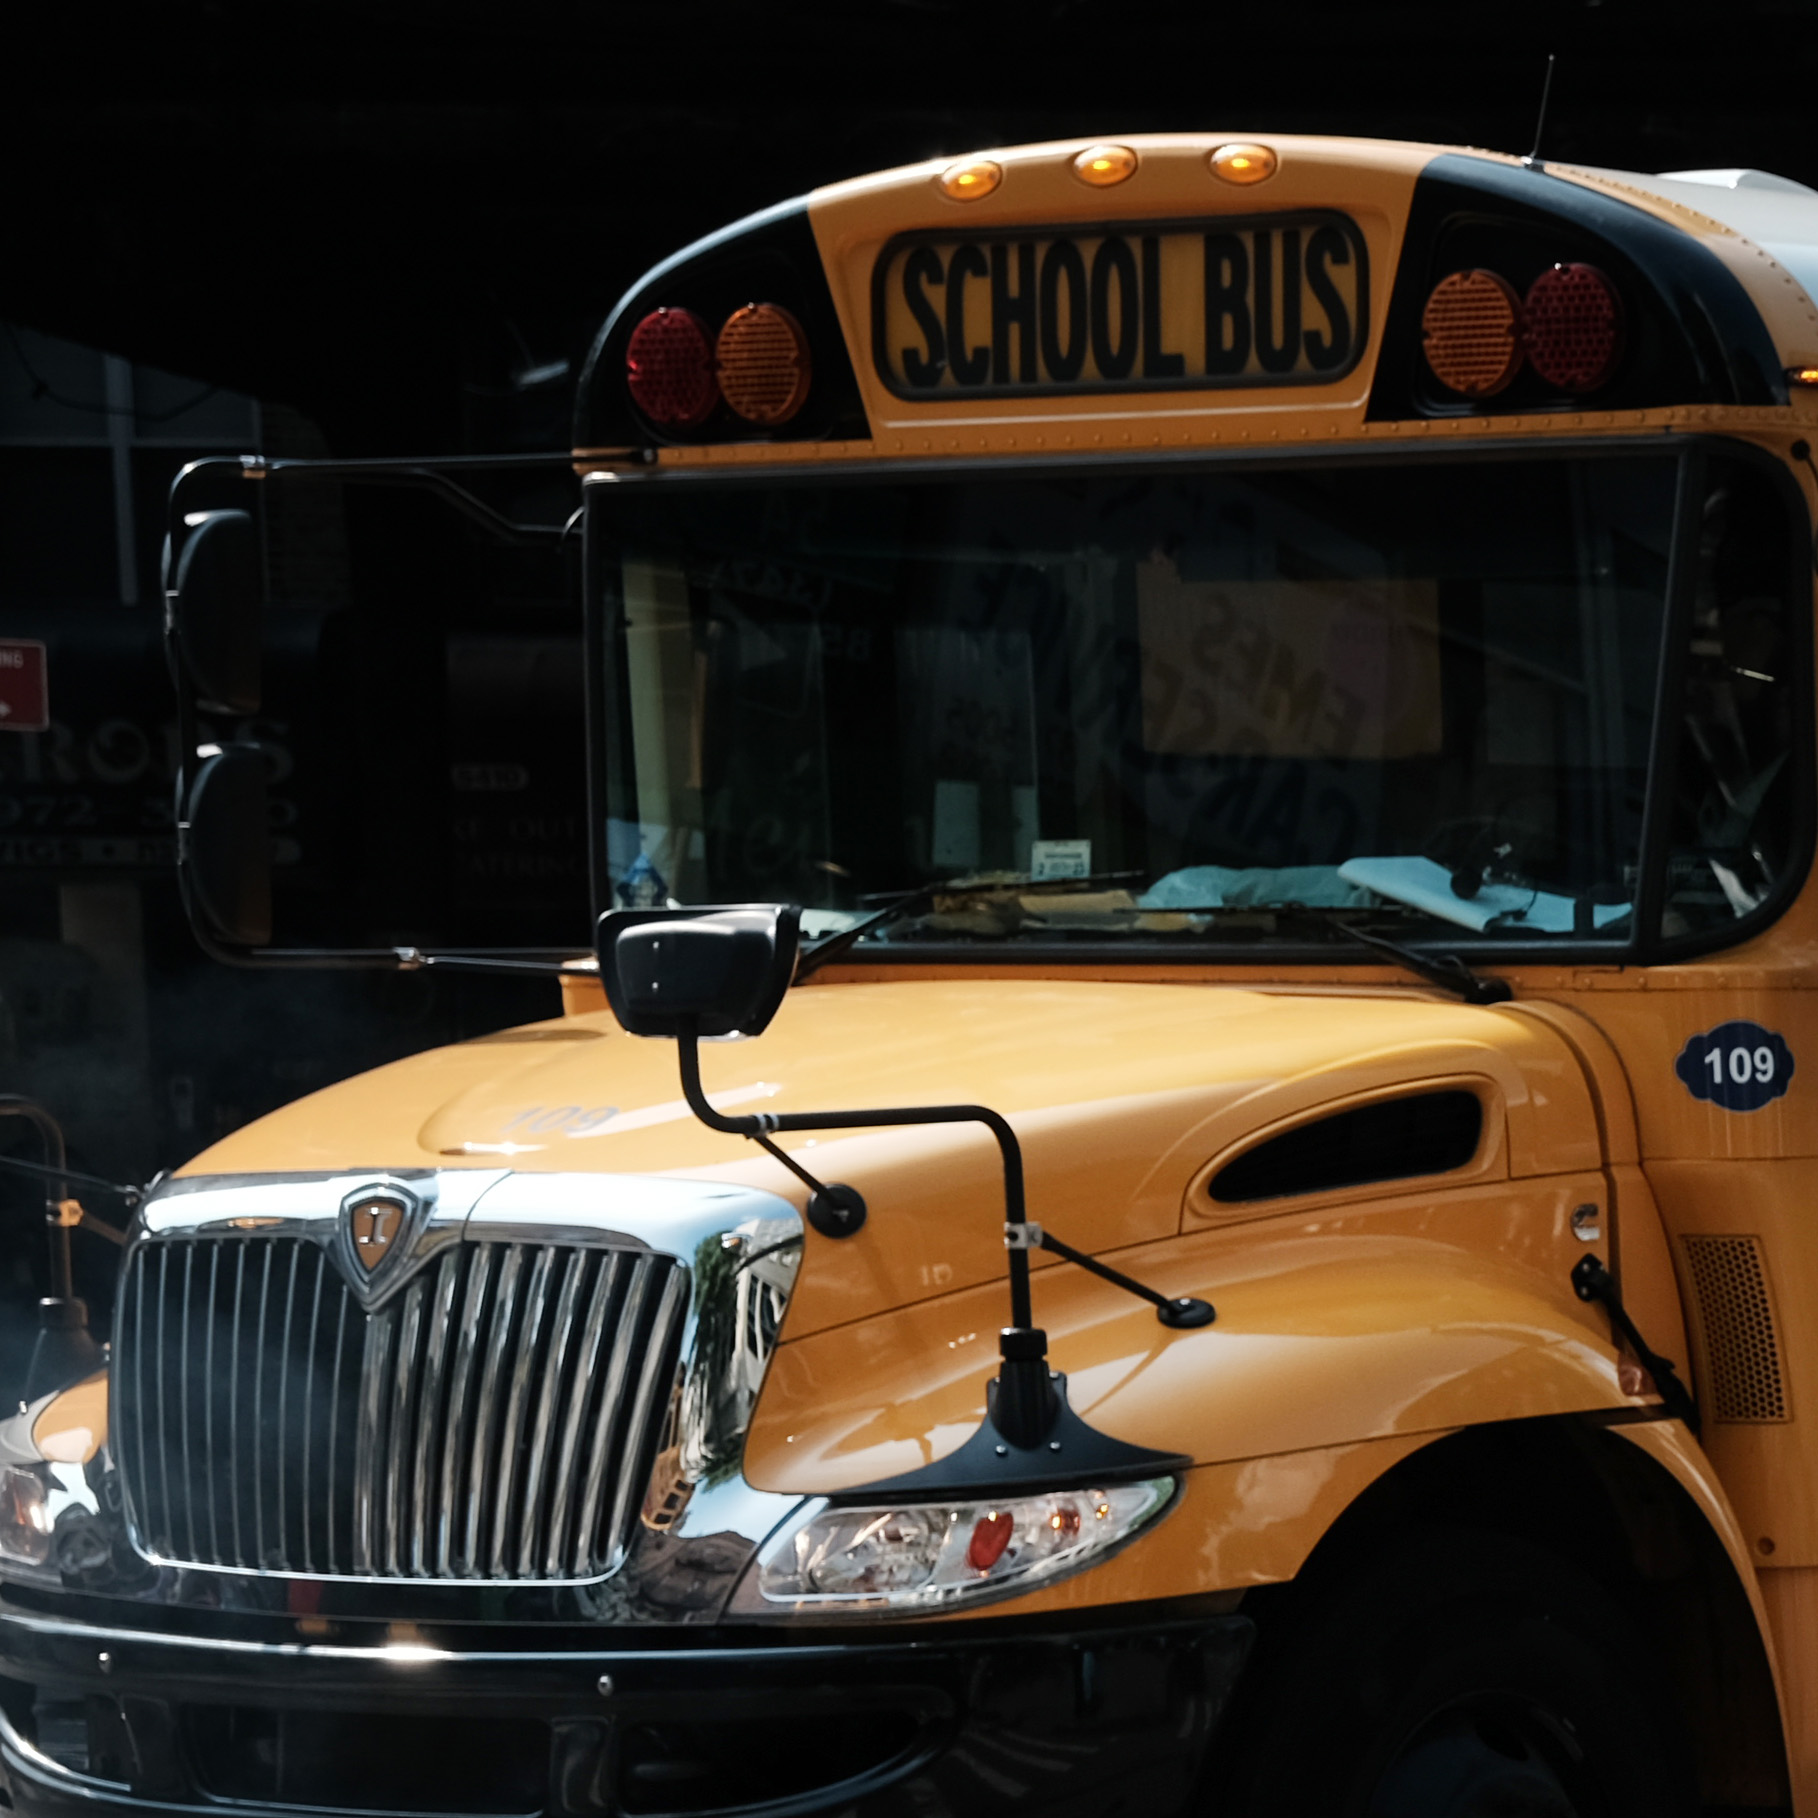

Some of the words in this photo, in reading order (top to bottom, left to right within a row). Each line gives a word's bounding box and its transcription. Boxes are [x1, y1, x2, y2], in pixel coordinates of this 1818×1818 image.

[902, 237, 1183, 388] SCHOOL
[1205, 224, 1352, 376] BUS
[1703, 1045, 1775, 1085] 109
